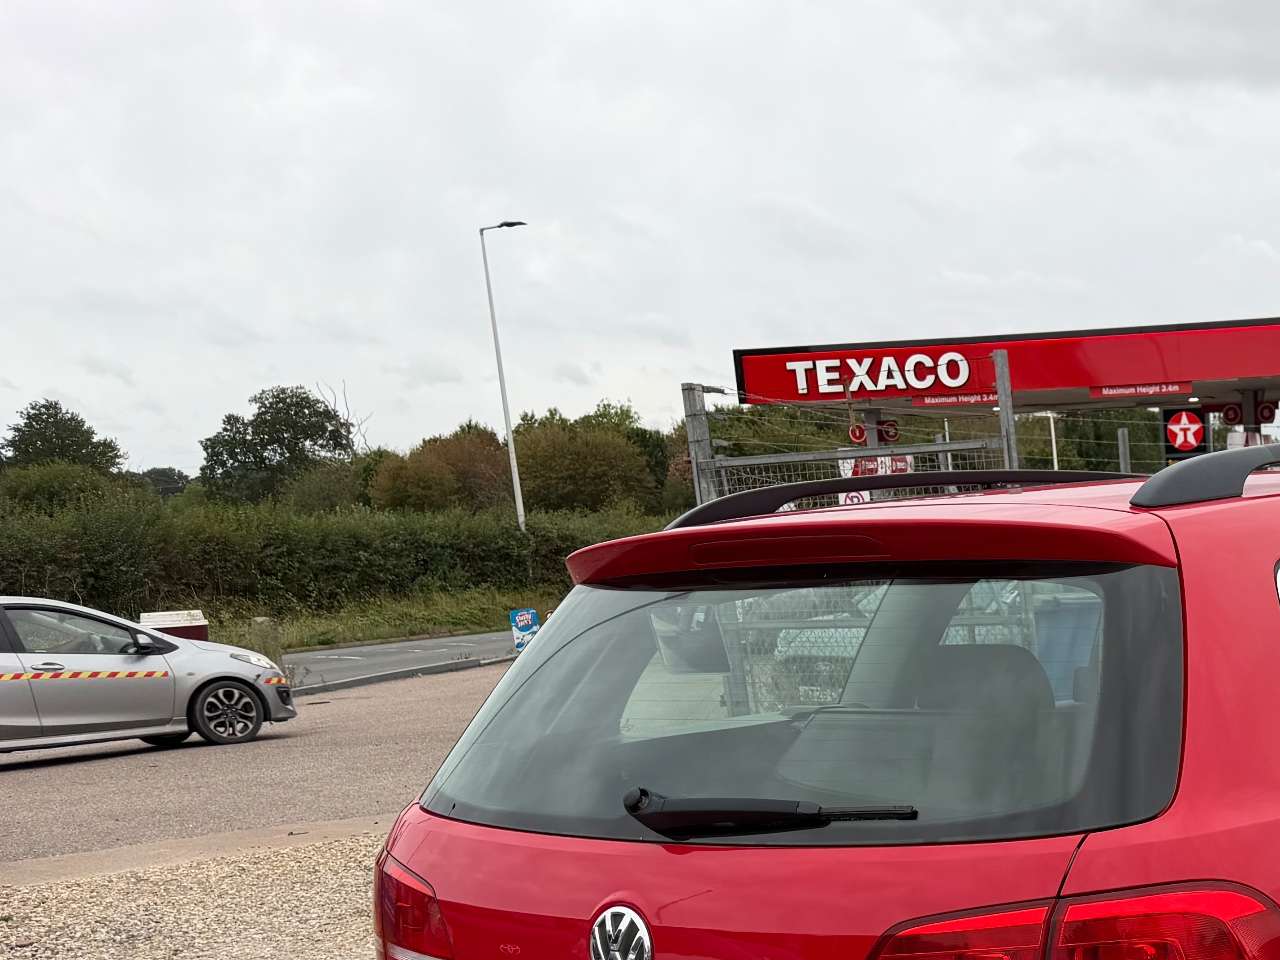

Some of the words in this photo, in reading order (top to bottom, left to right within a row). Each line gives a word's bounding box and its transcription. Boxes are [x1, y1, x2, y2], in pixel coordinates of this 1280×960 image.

[786, 351, 970, 394] TEXACO
[1102, 386, 1135, 395] Maximum
[1137, 384, 1160, 394] Height
[1161, 384, 1179, 392] 3.4m
[924, 395, 957, 404] Maximum
[959, 393, 981, 403] Height
